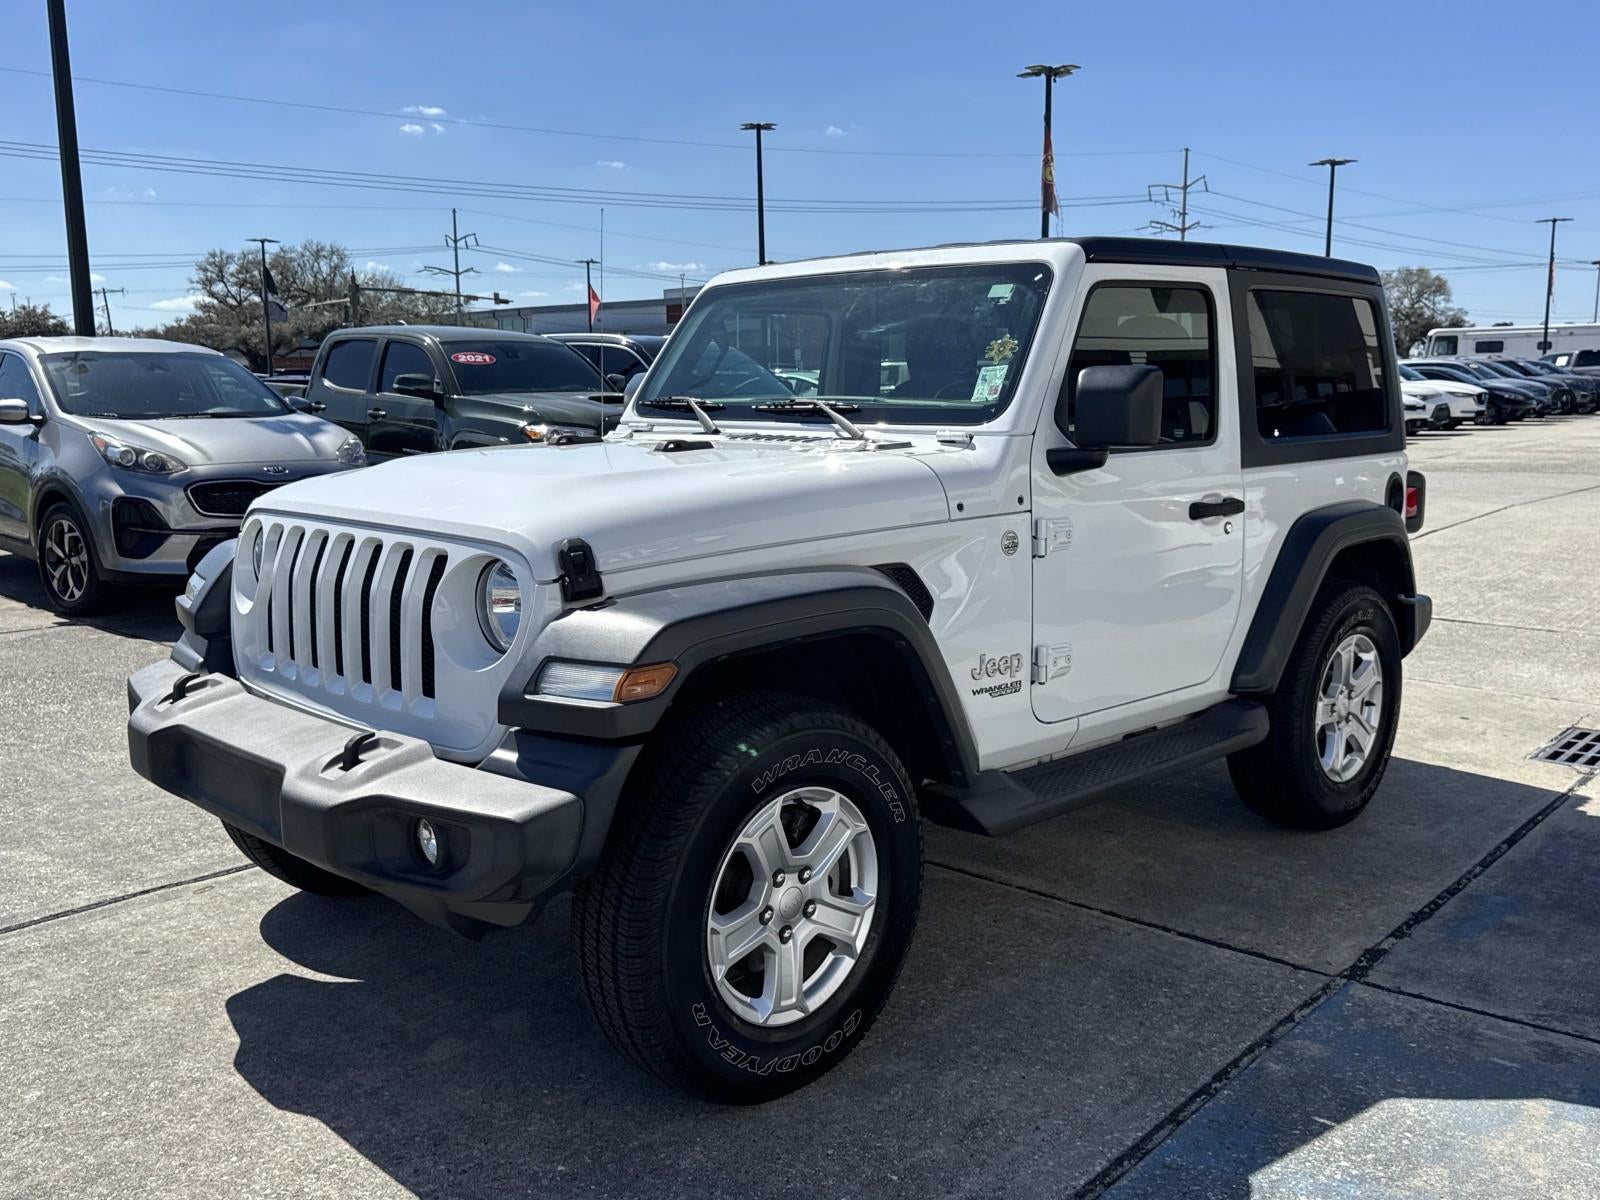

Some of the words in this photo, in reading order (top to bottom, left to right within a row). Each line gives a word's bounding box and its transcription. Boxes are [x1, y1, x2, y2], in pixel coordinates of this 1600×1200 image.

[458, 354, 490, 362] 2021
[971, 653, 1024, 680] Jeep
[971, 680, 1022, 696] WRANGLER
[751, 748, 906, 823] WRANGLER
[692, 1001, 862, 1076] GOODYEAR
